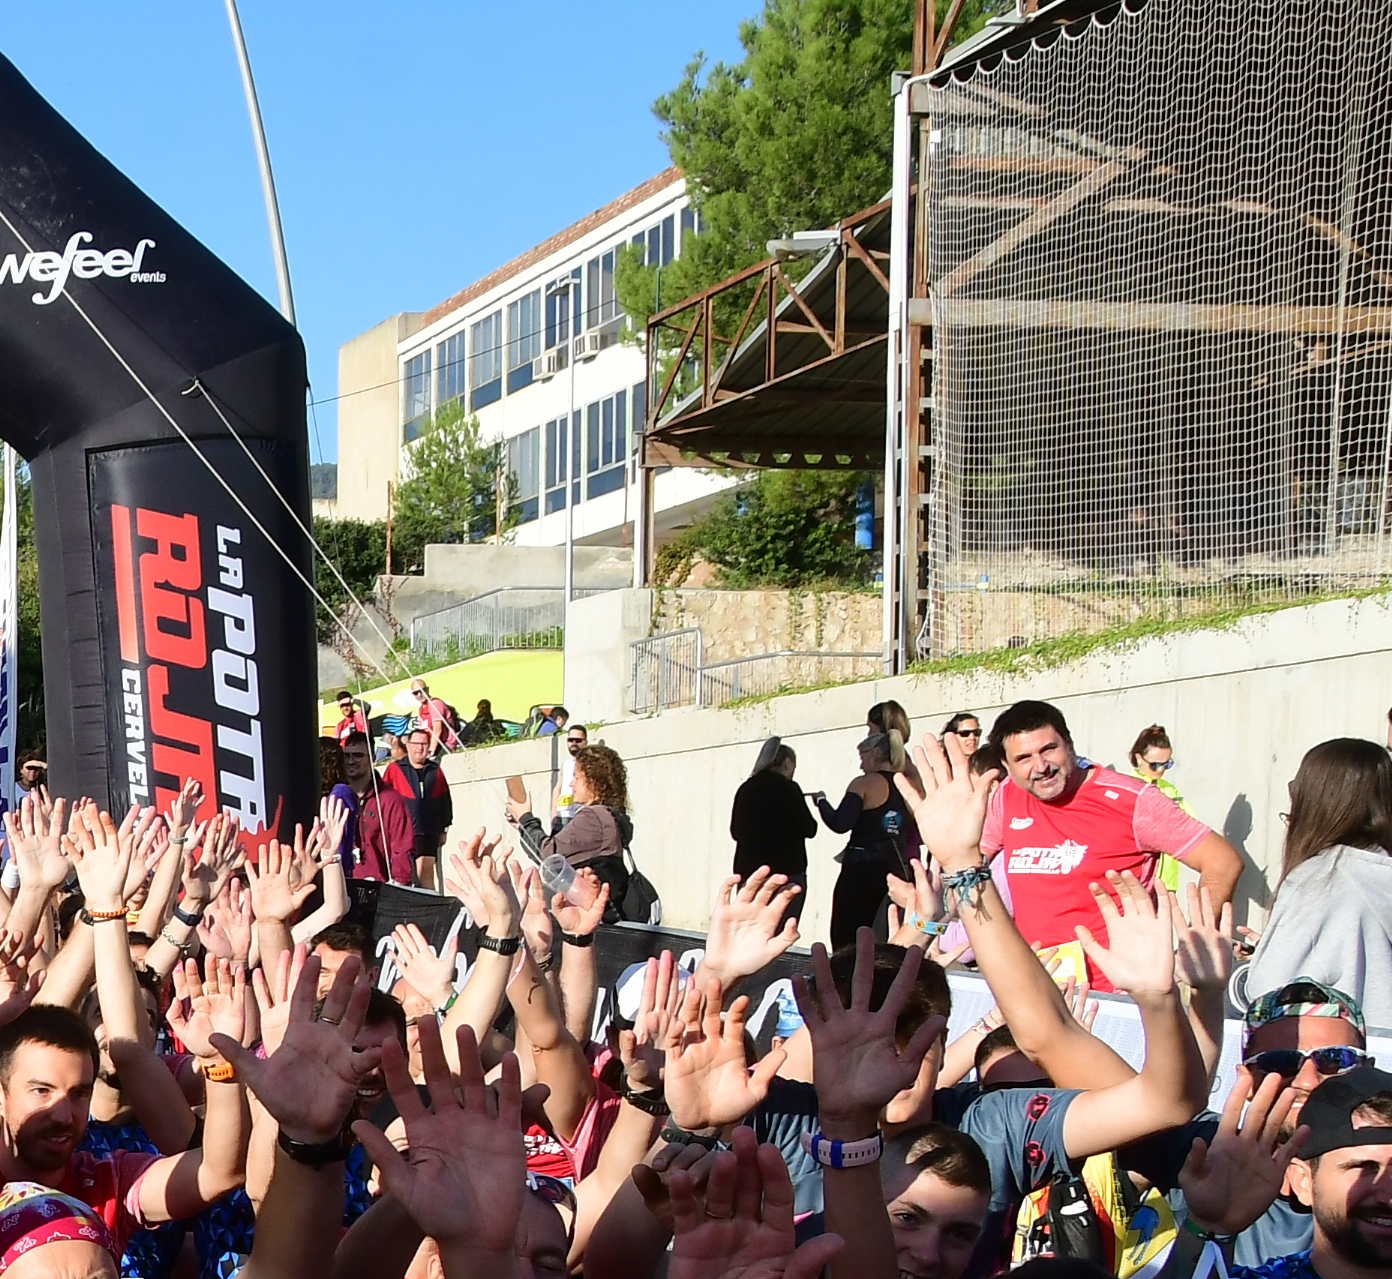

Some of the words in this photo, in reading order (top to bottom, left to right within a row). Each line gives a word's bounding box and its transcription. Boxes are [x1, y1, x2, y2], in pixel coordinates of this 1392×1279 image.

[130, 270, 167, 284] events
[216, 524, 244, 589] LA
[120, 667, 153, 836] CERVEL
[207, 585, 268, 836] POTA
